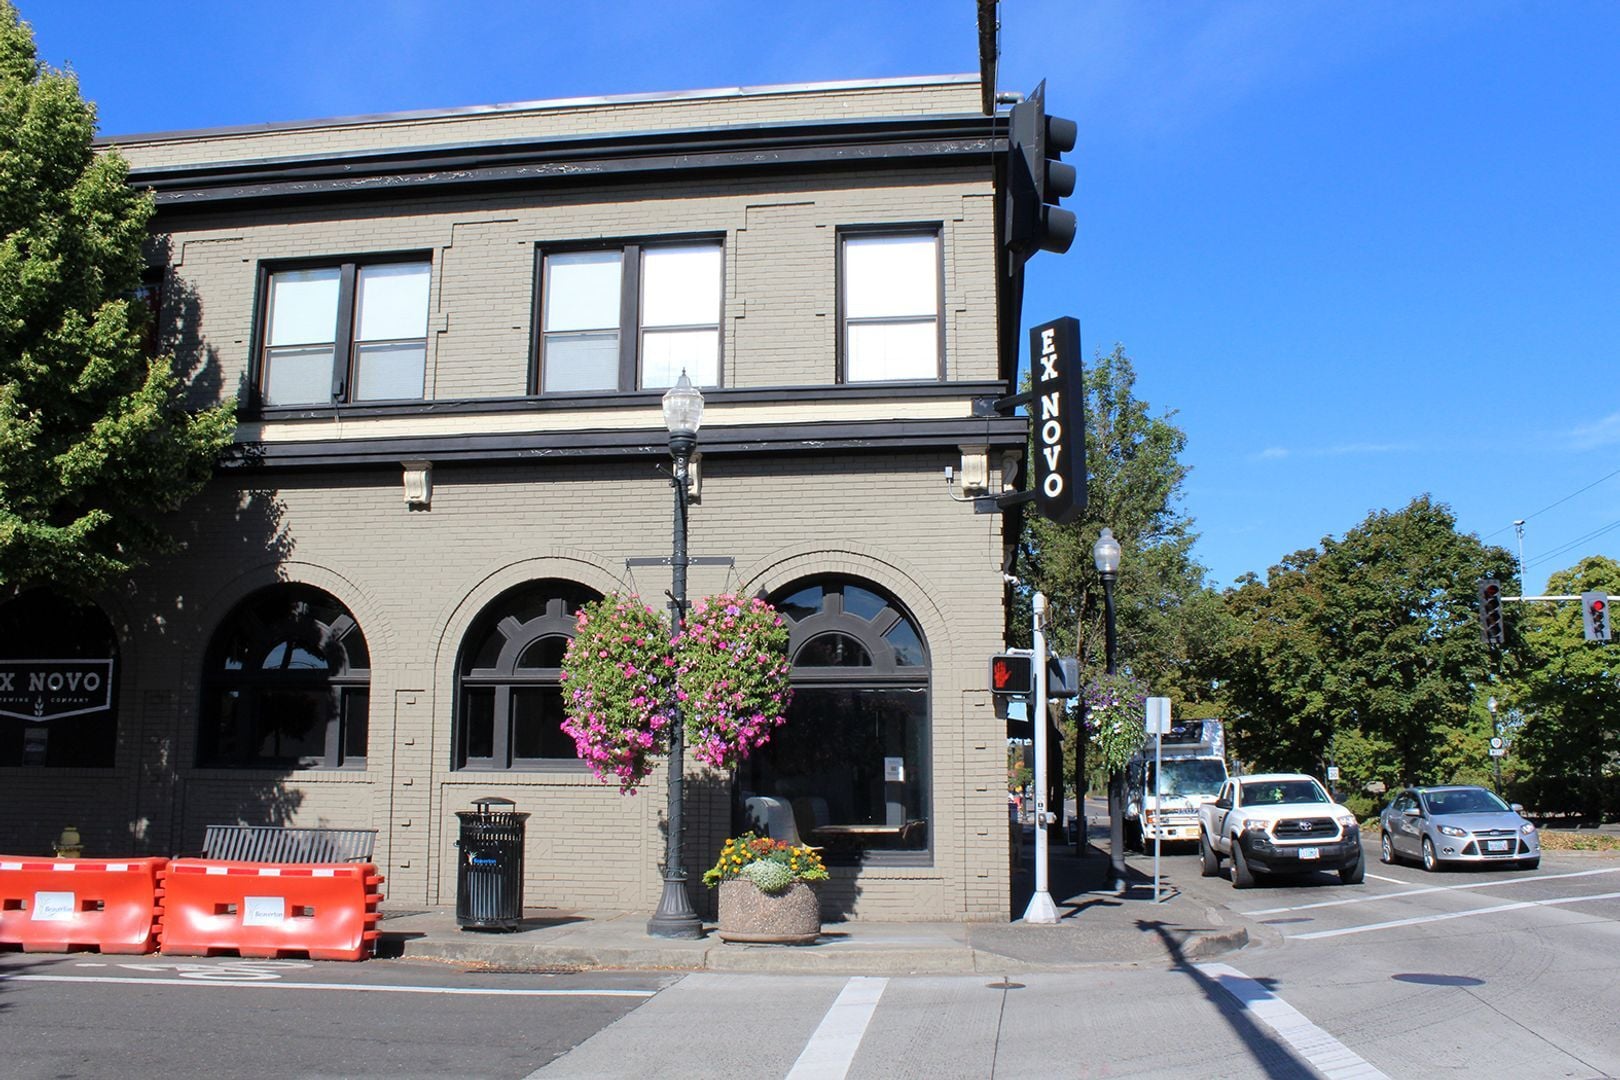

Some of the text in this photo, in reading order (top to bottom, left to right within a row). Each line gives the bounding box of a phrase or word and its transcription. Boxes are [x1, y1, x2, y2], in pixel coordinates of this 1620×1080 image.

[1040, 328, 1064, 498] EX NOVO
[28, 672, 100, 691] NOVO
